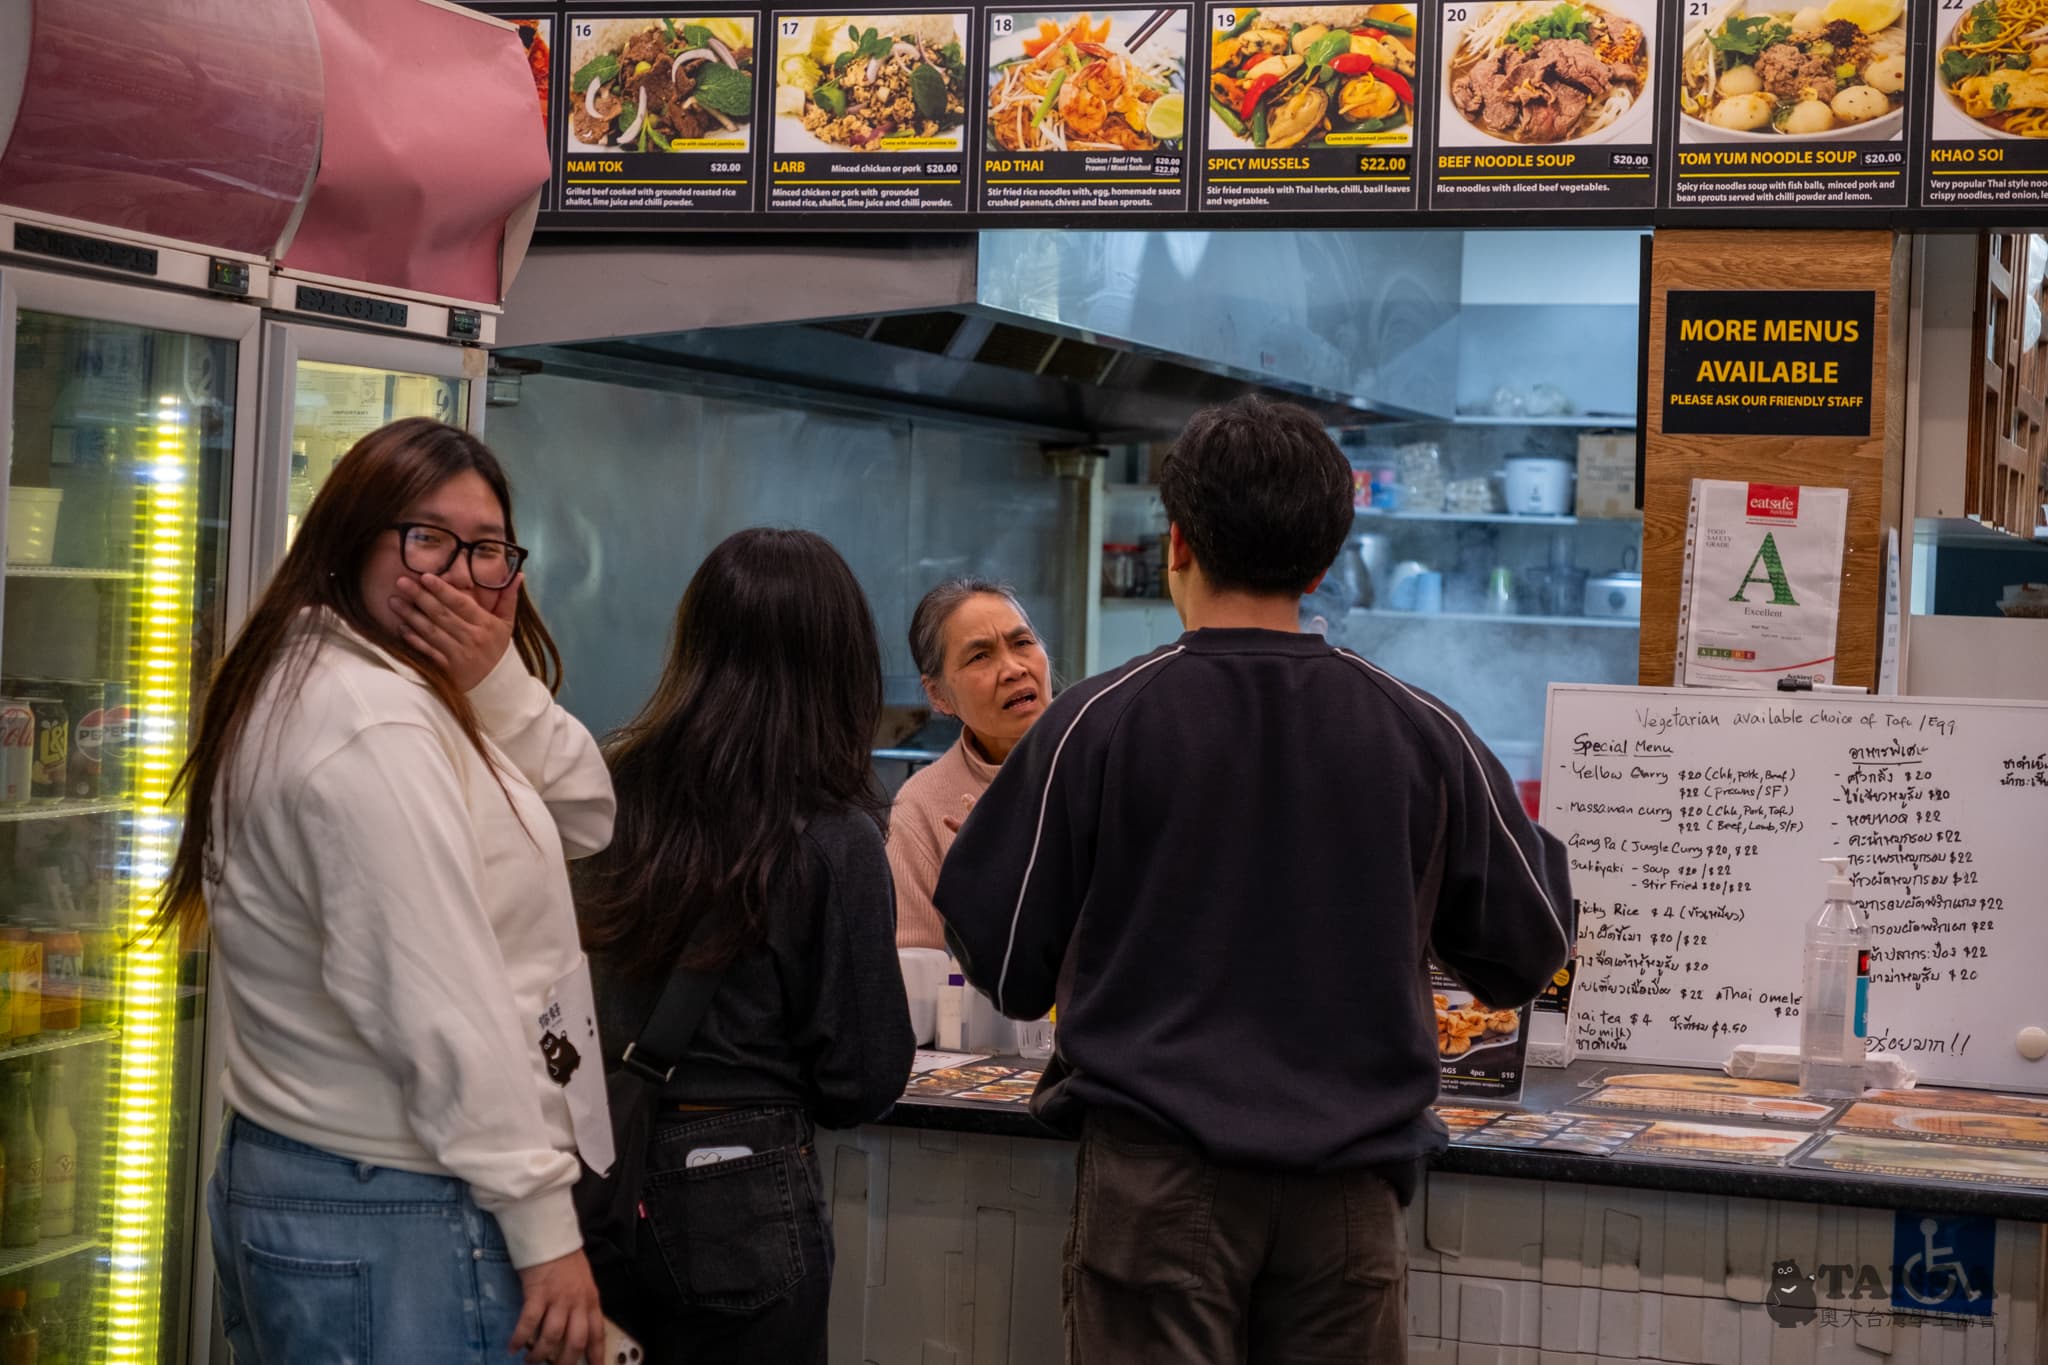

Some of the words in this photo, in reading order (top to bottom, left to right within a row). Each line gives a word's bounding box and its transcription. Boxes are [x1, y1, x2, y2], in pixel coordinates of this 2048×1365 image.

[1447, 9, 1466, 22] 20
[1689, 3, 1708, 15] 21
[995, 19, 1012, 32] 18
[1218, 14, 1235, 28] 19
[575, 24, 591, 38] 16
[782, 22, 798, 36] 17
[1439, 156, 1471, 168] BEEF
[1475, 155, 1533, 167] NOODLE
[1536, 154, 1575, 167] SOUP
[1613, 156, 1648, 165] $20.00
[1678, 153, 1711, 165] TOM
[1714, 152, 1747, 165] YUM
[1751, 151, 1813, 164] NOODLE
[1816, 151, 1857, 163] SOUP
[1865, 153, 1901, 164] $20.00
[1931, 149, 1975, 161] KHAO
[1978, 149, 2003, 161] SOI
[567, 161, 596, 172] NAM
[599, 161, 623, 172] TOK
[710, 163, 741, 172] $20.00
[773, 161, 805, 173] LARB
[902, 165, 921, 174] pork
[927, 164, 958, 173] $20.00
[986, 160, 1011, 172] PAD
[1014, 160, 1044, 171] THAI
[1208, 158, 1246, 171] SPICY
[1249, 158, 1310, 170] MUSSELS
[1360, 158, 1406, 171] $22.00
[1207, 186, 1221, 195] Stir
[1222, 186, 1241, 195] fried
[1243, 186, 1275, 194] mussels
[1276, 186, 1294, 194] with
[1296, 186, 1313, 194] Thai
[1315, 186, 1339, 194] herbs,
[1341, 185, 1362, 194] chilli,
[1364, 185, 1383, 193] basil
[1385, 185, 1410, 193] leaves
[1437, 184, 1455, 193] Rice
[1456, 184, 1490, 193] noodles
[1492, 184, 1511, 192] with
[1513, 183, 1537, 192] sliced
[1539, 183, 1559, 191] beef
[1560, 183, 1610, 193] vegetables.
[1677, 182, 1698, 192] Spicy
[1700, 182, 1714, 190] rice
[1715, 181, 1746, 190] noodles
[1748, 182, 1767, 192] soup
[1769, 181, 1786, 190] with
[1788, 181, 1802, 189] fish
[1804, 181, 1825, 190] balls,
[1828, 180, 1857, 189] minced
[1859, 180, 1877, 190] pork
[1879, 180, 1895, 188] and
[1930, 180, 1950, 190] Very
[1952, 179, 1986, 189] popular
[1988, 179, 2006, 187] Thai
[2008, 179, 2029, 189] style
[772, 188, 800, 196] Minced
[801, 188, 830, 196] chicken
[841, 188, 859, 198] pork
[861, 188, 878, 196] with
[881, 188, 919, 198] grounded
[988, 188, 1002, 196] Stir
[1003, 188, 1022, 196] fried
[1023, 188, 1037, 196] rice
[1038, 188, 1071, 196] noodles
[1072, 188, 1092, 197] with,
[1093, 189, 1110, 198] egg,
[1112, 187, 1157, 196] homemade
[1677, 193, 1696, 202] bean
[1698, 193, 1727, 203] sprouts
[1729, 193, 1755, 201] served
[1756, 193, 1774, 201] with
[1775, 192, 1794, 201] chilli
[1796, 193, 1826, 202] powder
[1827, 192, 1843, 200] and
[1845, 192, 1872, 200] lemon.
[1020, 199, 1054, 207] peanuts,
[1120, 199, 1152, 207] sprouts.
[1223, 197, 1269, 206] vegetables.
[1680, 319, 1757, 341] MORE
[1764, 320, 1859, 342] MENUS
[1696, 361, 1838, 383] AVAILABLE
[1671, 394, 1713, 405] PLEASE
[1716, 395, 1739, 405] ASK
[1741, 395, 1767, 406] OUR
[1769, 396, 1825, 407] FRIENDLY
[1827, 396, 1863, 407] STAFF
[1750, 497, 1794, 510] eatsafe
[1729, 532, 1800, 606] A
[1744, 607, 1782, 617] Excellent
[1636, 707, 1719, 735] Vegetarian
[1733, 708, 1803, 725] available
[1810, 709, 1853, 724] choice
[1860, 714, 1877, 729] of
[1573, 733, 1628, 756] Special
[1635, 740, 1674, 753] Menu
[1572, 762, 1622, 780] Yellow
[1614, 903, 1639, 916] Rice
